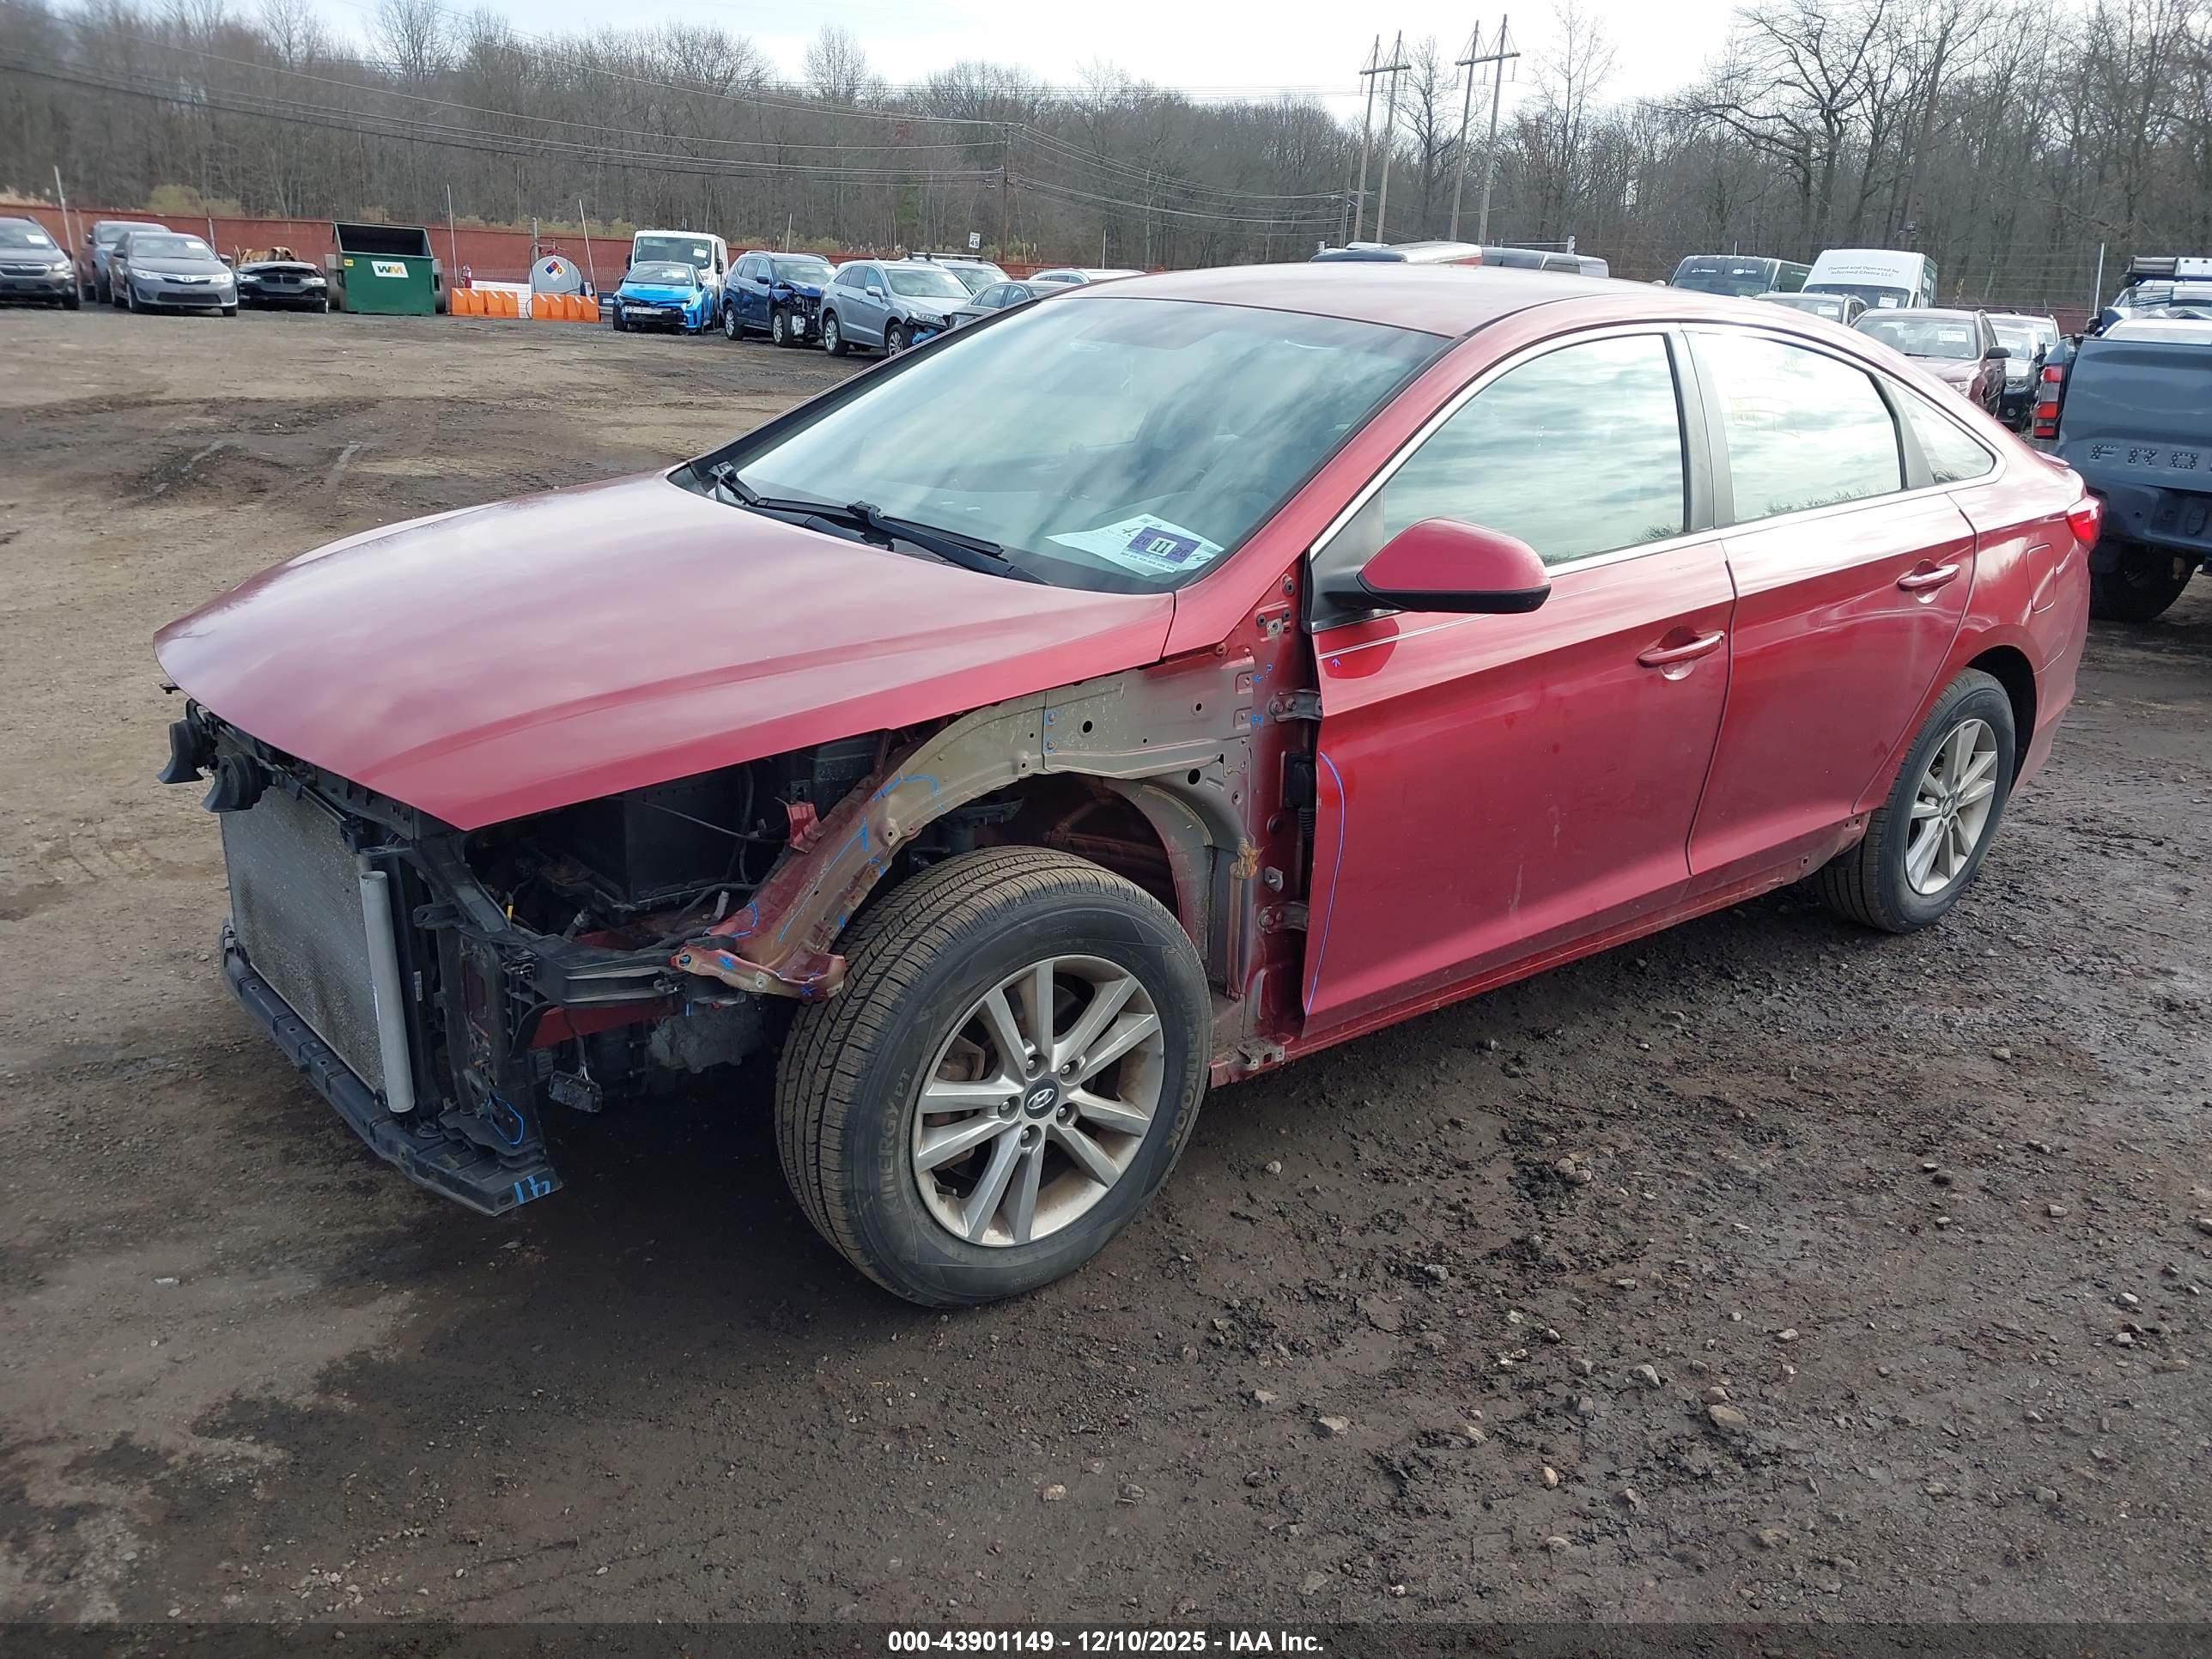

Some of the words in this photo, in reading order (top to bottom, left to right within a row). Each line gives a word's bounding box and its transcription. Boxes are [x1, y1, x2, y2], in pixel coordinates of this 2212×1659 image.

[377, 265, 404, 274] WM
[2090, 444, 2212, 471] FRO
[1135, 536, 1152, 546] 20
[1151, 540, 1171, 554] 11
[1171, 547, 1190, 557] 26
[896, 1071, 910, 1101] PT
